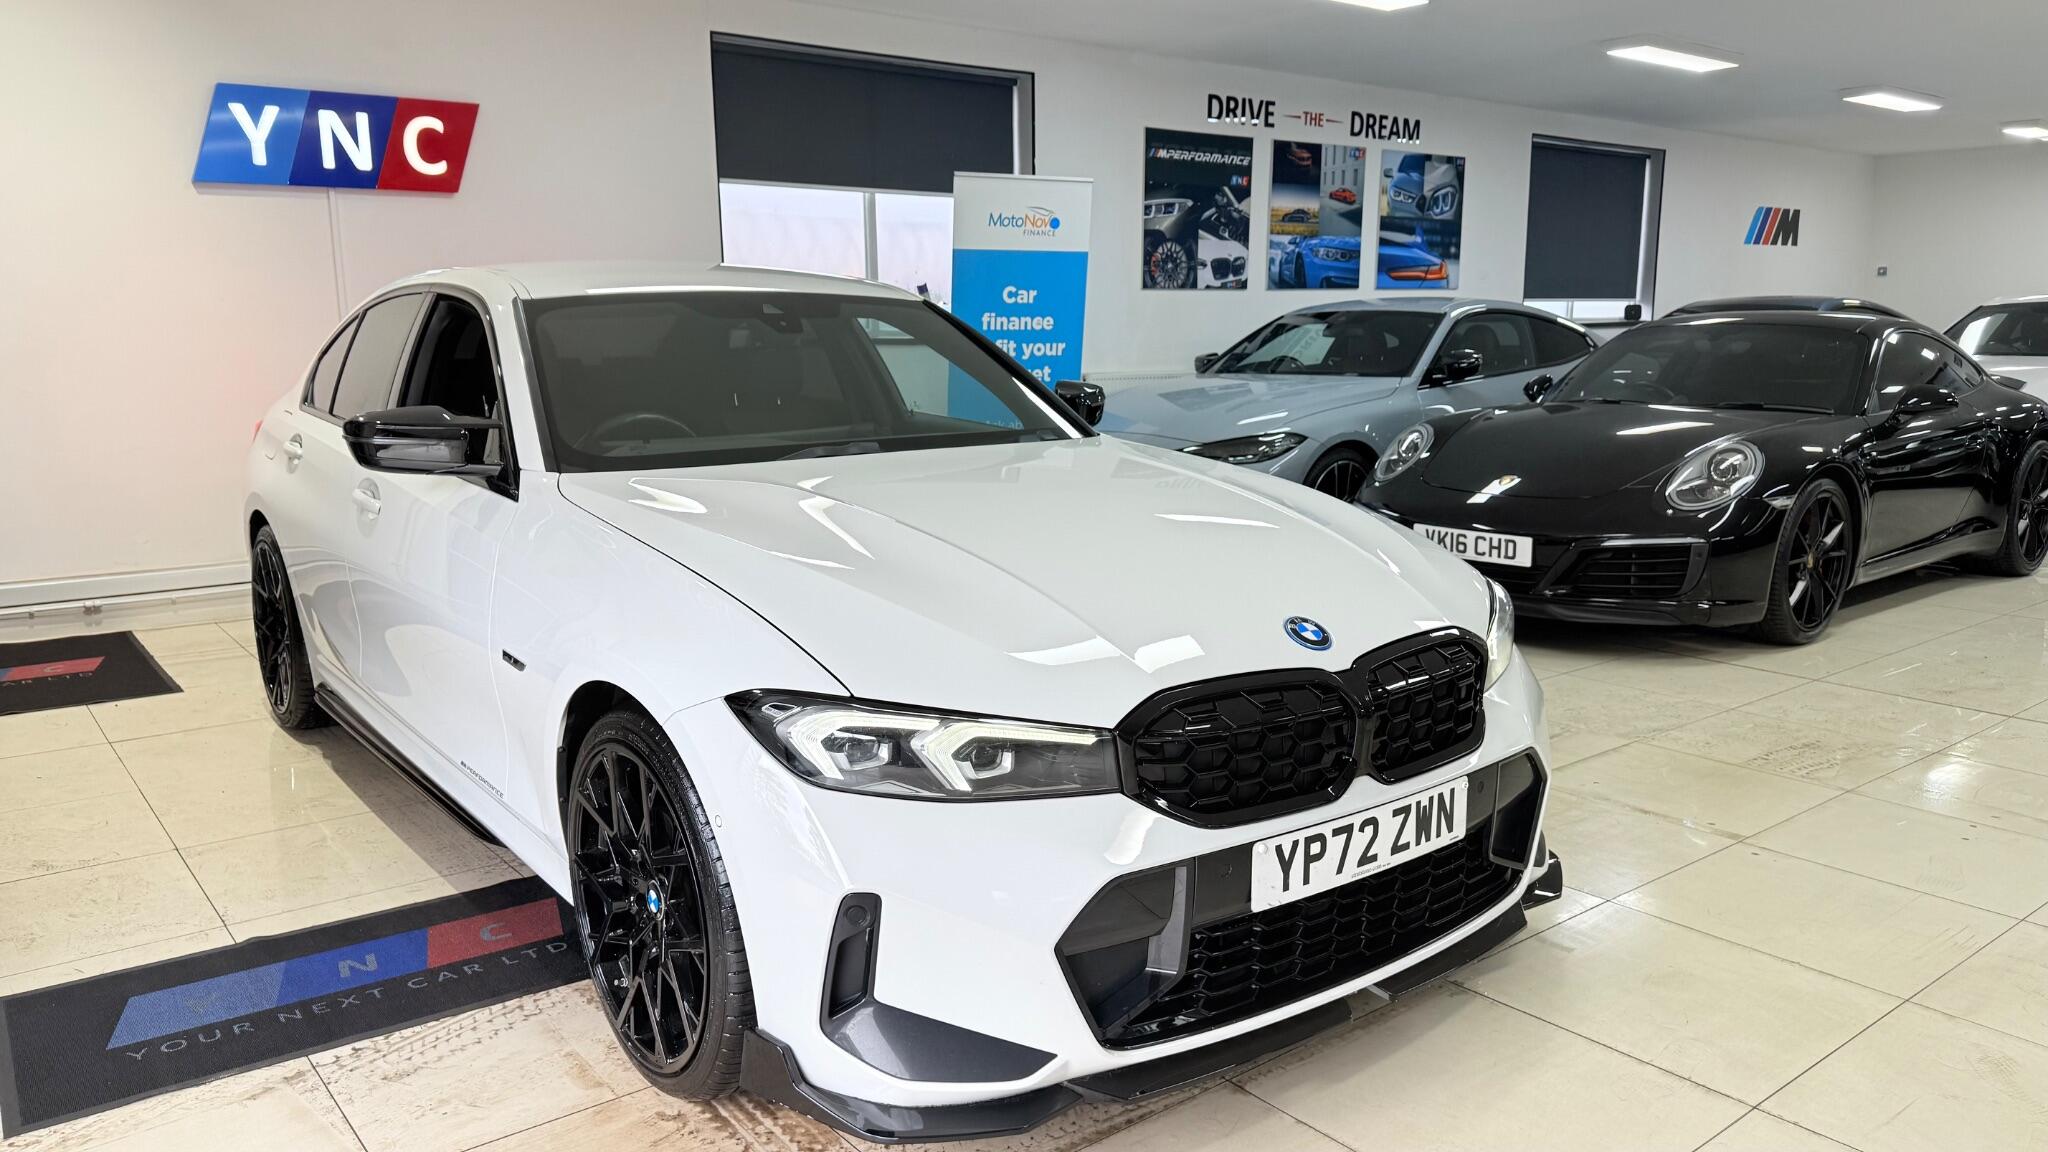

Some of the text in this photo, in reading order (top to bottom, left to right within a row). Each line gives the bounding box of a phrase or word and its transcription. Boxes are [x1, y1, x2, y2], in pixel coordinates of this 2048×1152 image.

[1207, 93, 1421, 144] DRIVE THE DREAM
[228, 102, 448, 176] YNC
[1023, 229, 1056, 237] FINANCE
[1002, 285, 1038, 304] Car
[981, 312, 1054, 330] finance
[1021, 342, 1066, 360] your
[1474, 535, 1517, 560] CHD
[1275, 787, 1455, 893] YP72 ZWN
[126, 942, 568, 1061] YOUR NEXT CAR LTD
